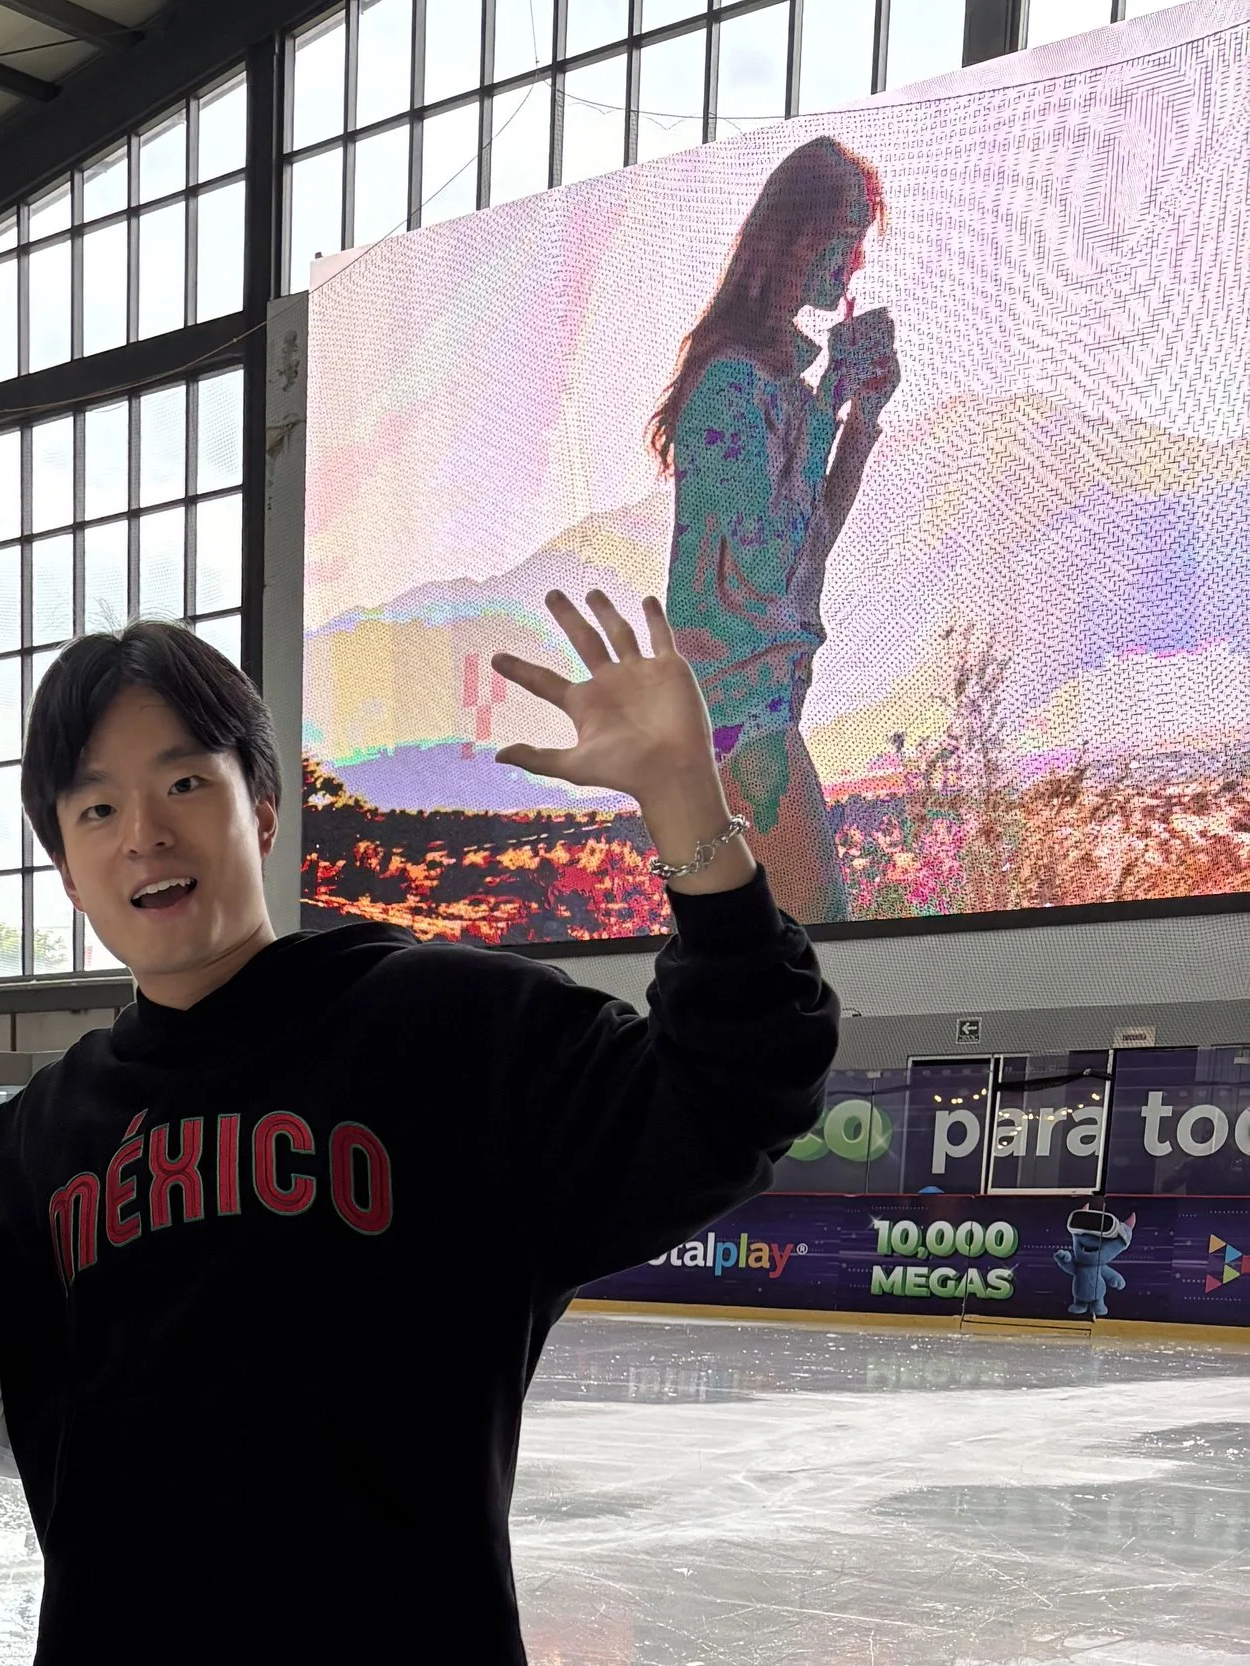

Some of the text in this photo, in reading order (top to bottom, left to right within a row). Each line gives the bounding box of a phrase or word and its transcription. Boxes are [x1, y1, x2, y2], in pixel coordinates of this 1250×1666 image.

[931, 1105, 1100, 1174] para
[50, 1109, 393, 1298] MÉXICO
[873, 1219, 1019, 1260] 10,000
[870, 1265, 1015, 1300] MEGAS
